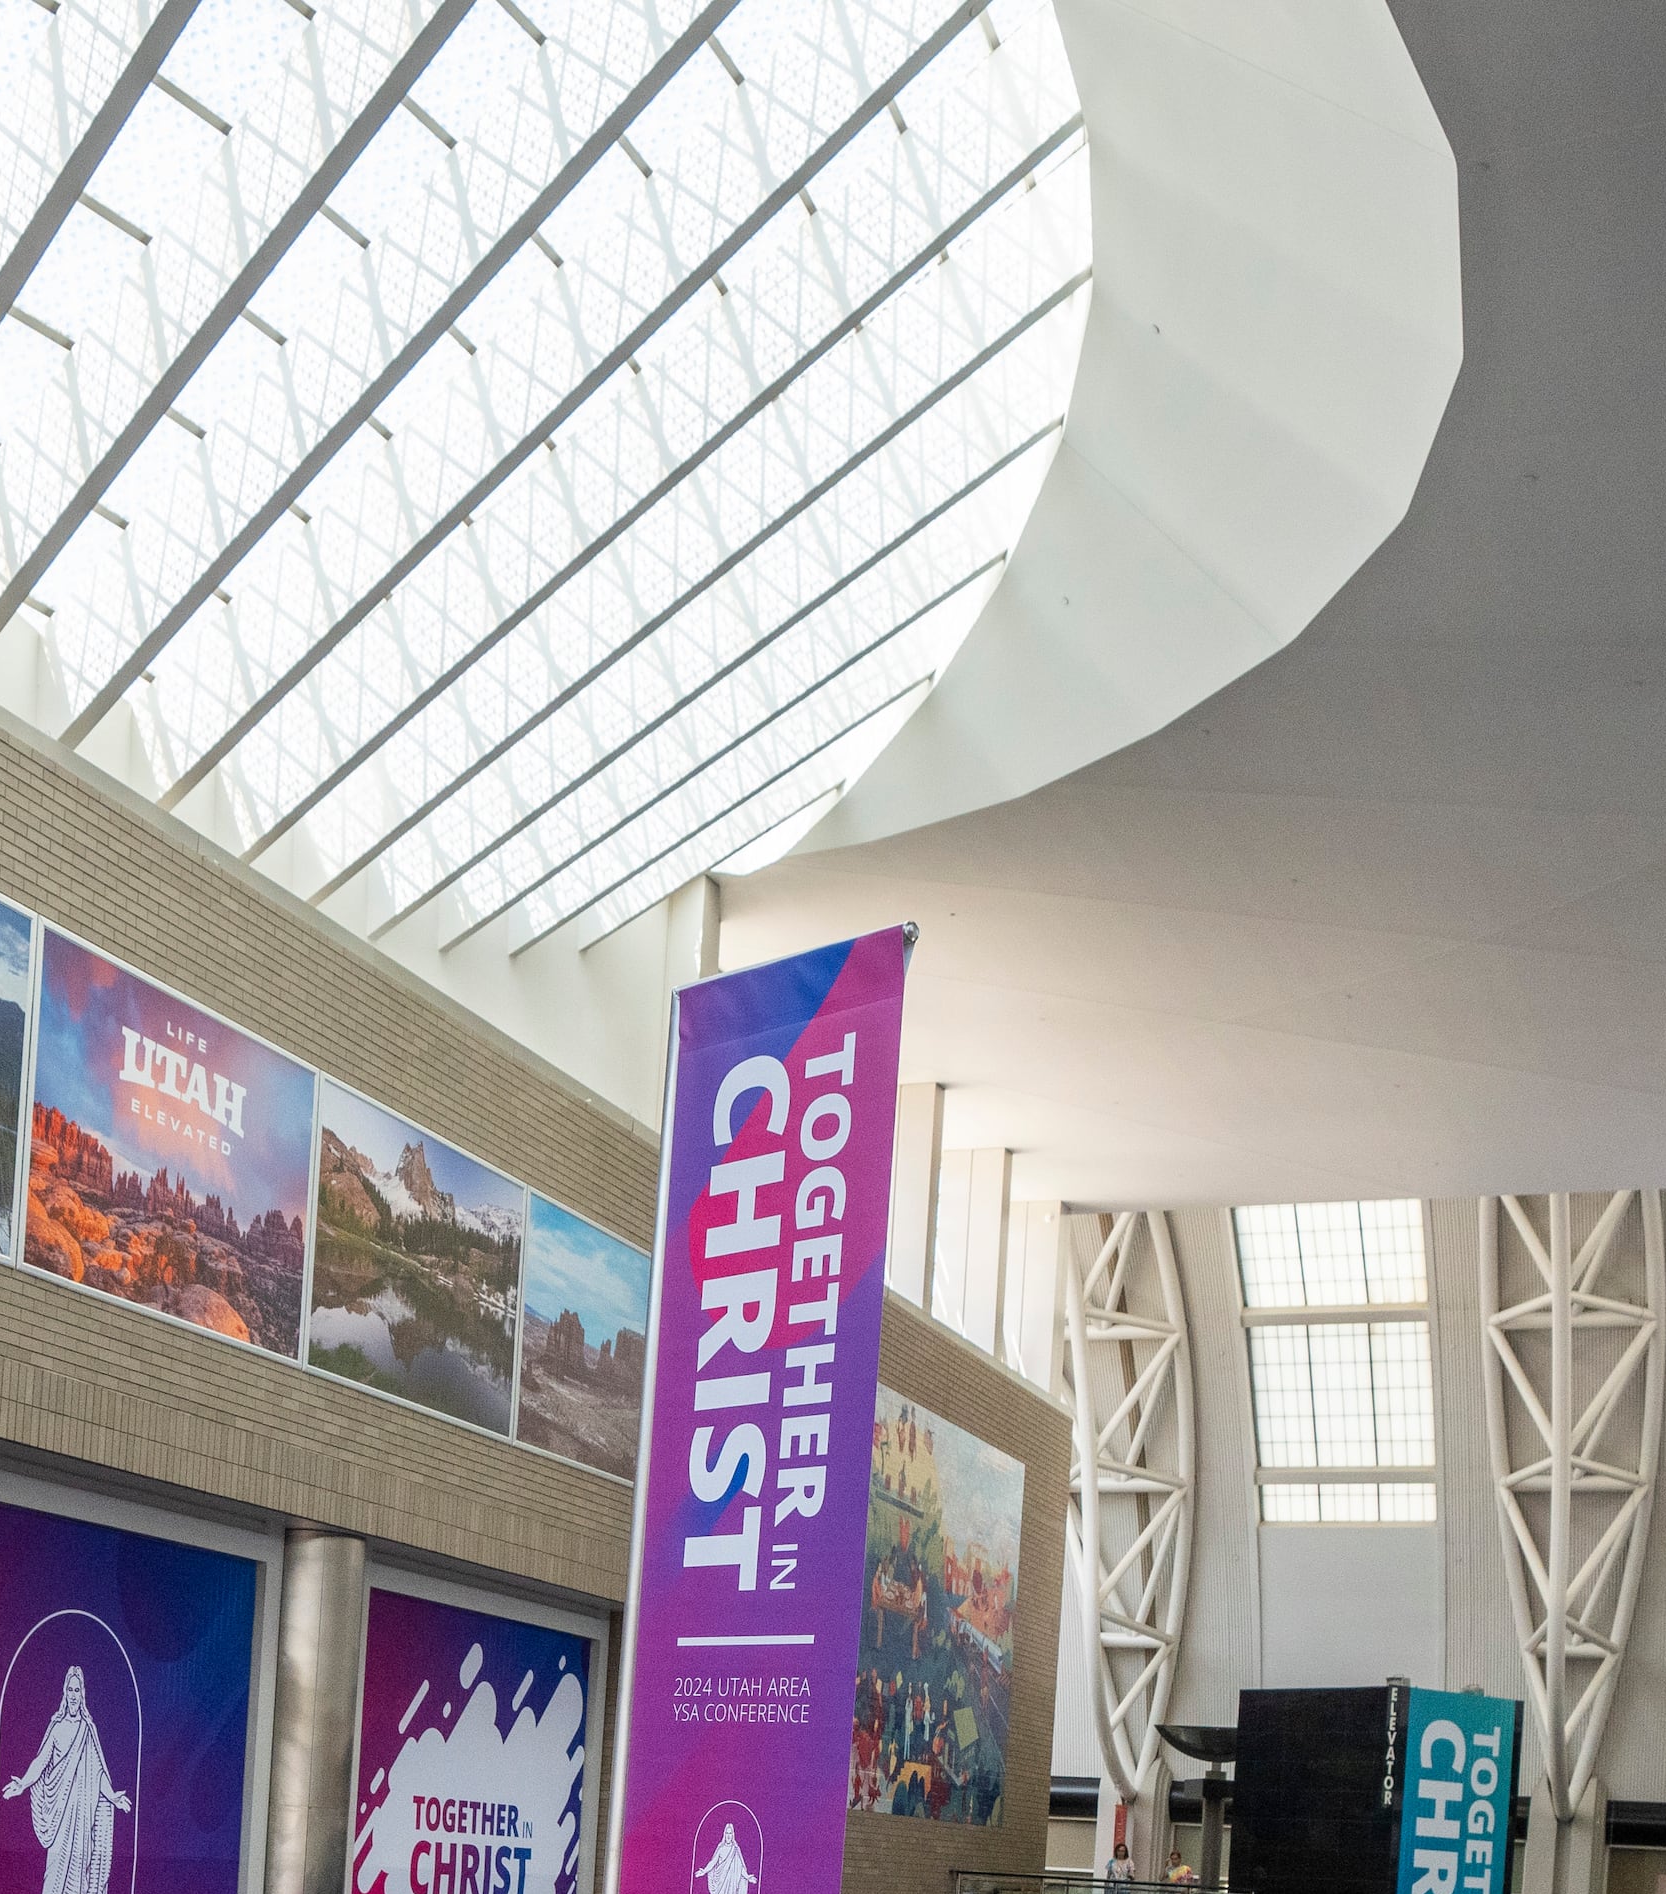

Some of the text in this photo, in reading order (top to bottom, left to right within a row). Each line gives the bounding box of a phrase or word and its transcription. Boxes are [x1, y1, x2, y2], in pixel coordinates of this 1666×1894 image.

[166, 1021, 208, 1054] LIFE
[118, 1025, 247, 1139] UTAH
[131, 1098, 232, 1156] ELEVATED
[683, 1055, 791, 1591] CHRIST
[769, 1032, 856, 1590] TOGETHER IN
[673, 1703, 809, 1724] YSA CONFERENCE
[674, 1677, 811, 1697] 2024 UTAH AREA
[1383, 1687, 1398, 1806] ELEVATOR
[413, 1796, 533, 1839] TOGETHER IN
